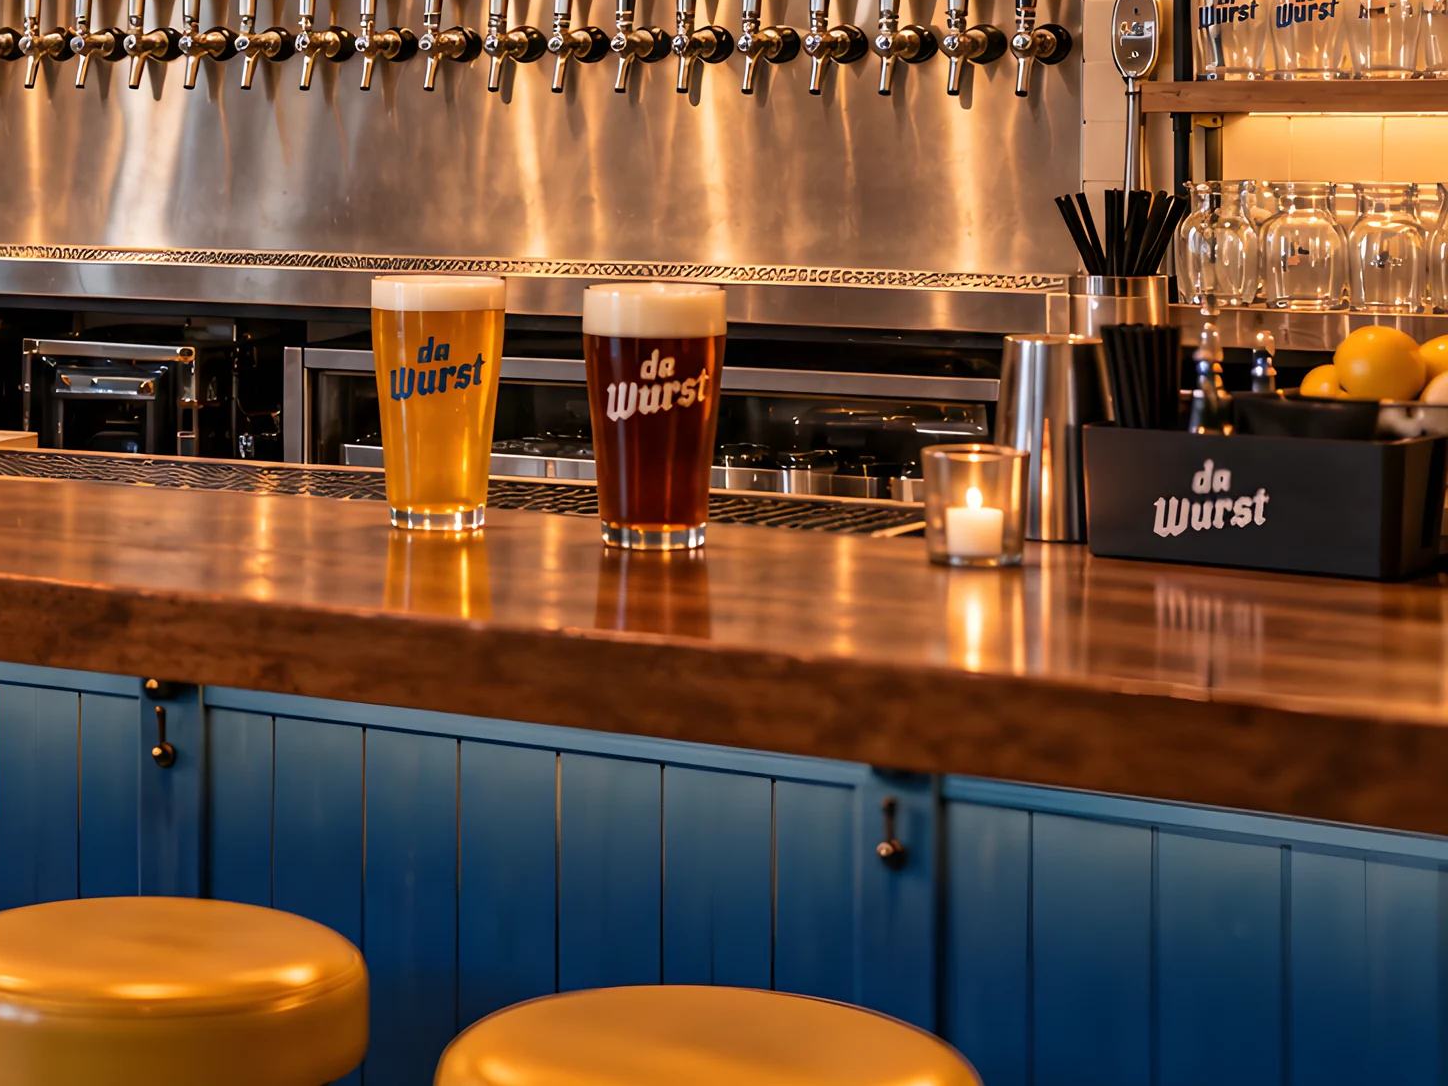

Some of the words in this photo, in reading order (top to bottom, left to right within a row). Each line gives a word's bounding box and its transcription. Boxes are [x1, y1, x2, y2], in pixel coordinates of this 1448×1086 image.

[417, 337, 450, 364] da
[640, 349, 675, 379] da
[390, 353, 485, 401] Wurst
[606, 368, 709, 422] Wurst
[1192, 459, 1231, 495] da
[1153, 488, 1269, 538] Wurst
